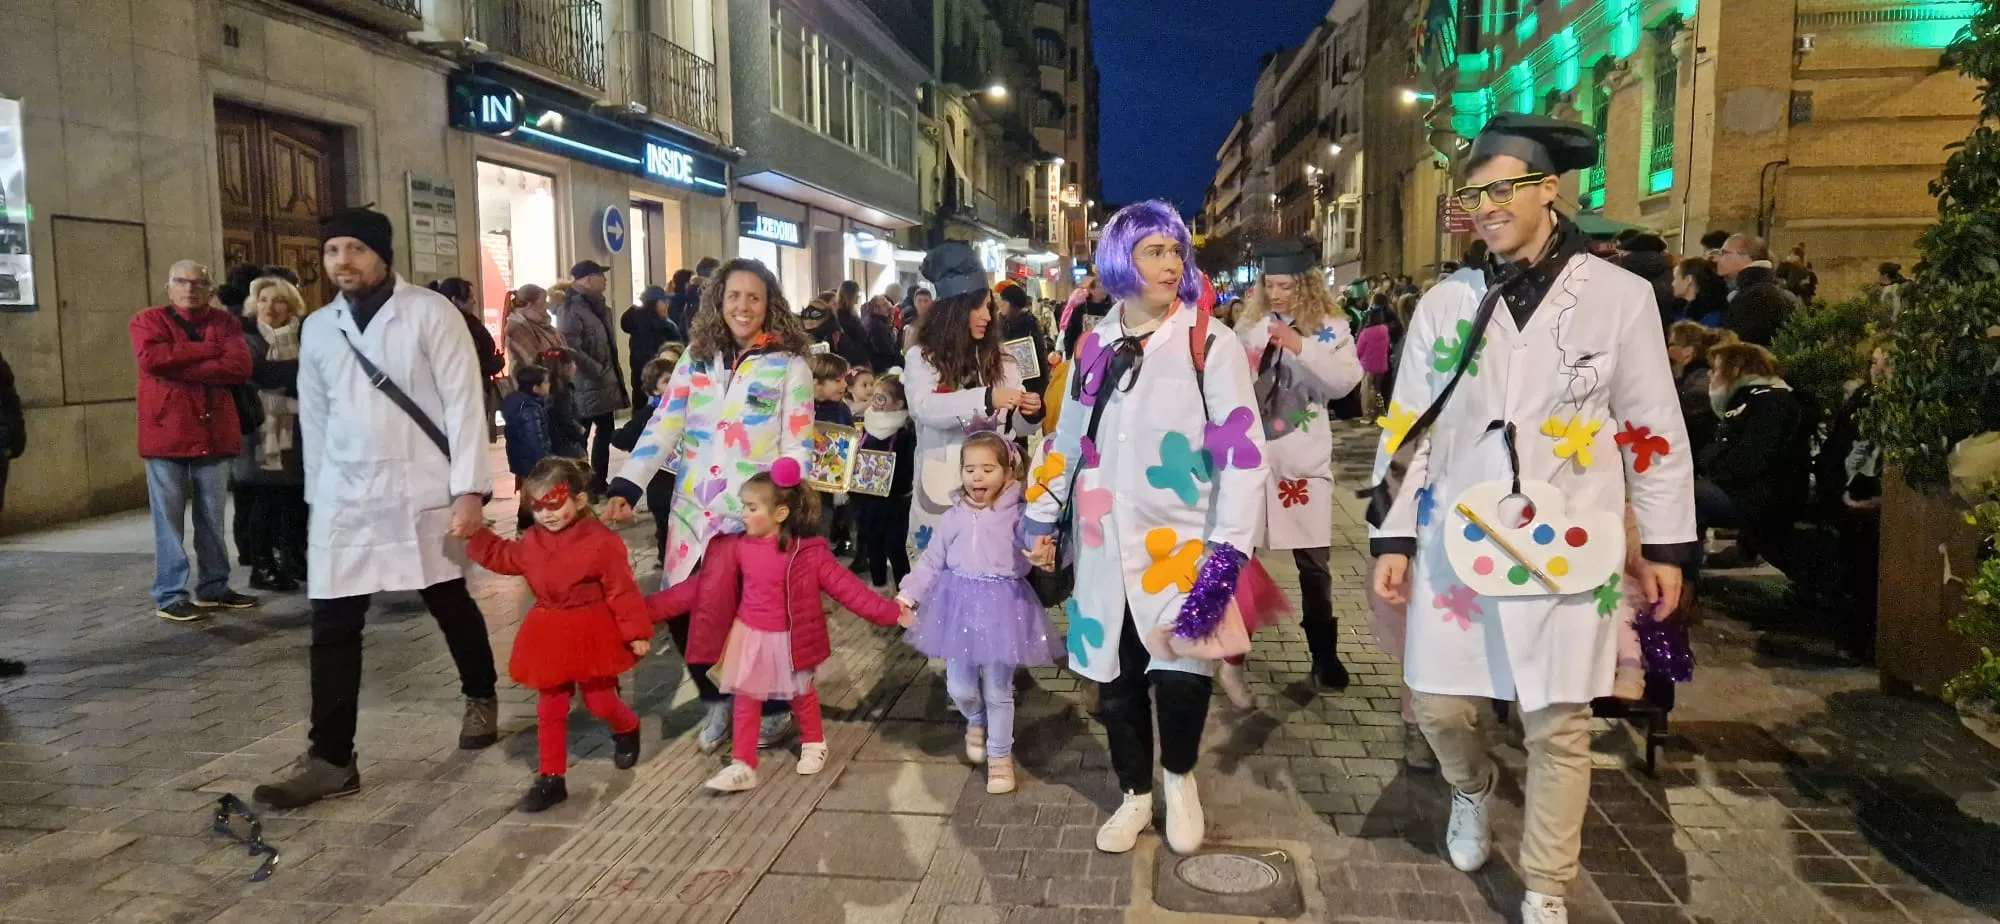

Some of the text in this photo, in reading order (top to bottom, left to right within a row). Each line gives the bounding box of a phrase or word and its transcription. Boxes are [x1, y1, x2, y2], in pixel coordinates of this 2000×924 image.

[482, 95, 512, 122] IN
[647, 143, 694, 184] INSIDE
[1049, 164, 1059, 240] FARMACIA
[747, 215, 798, 243] LZEDONIA
